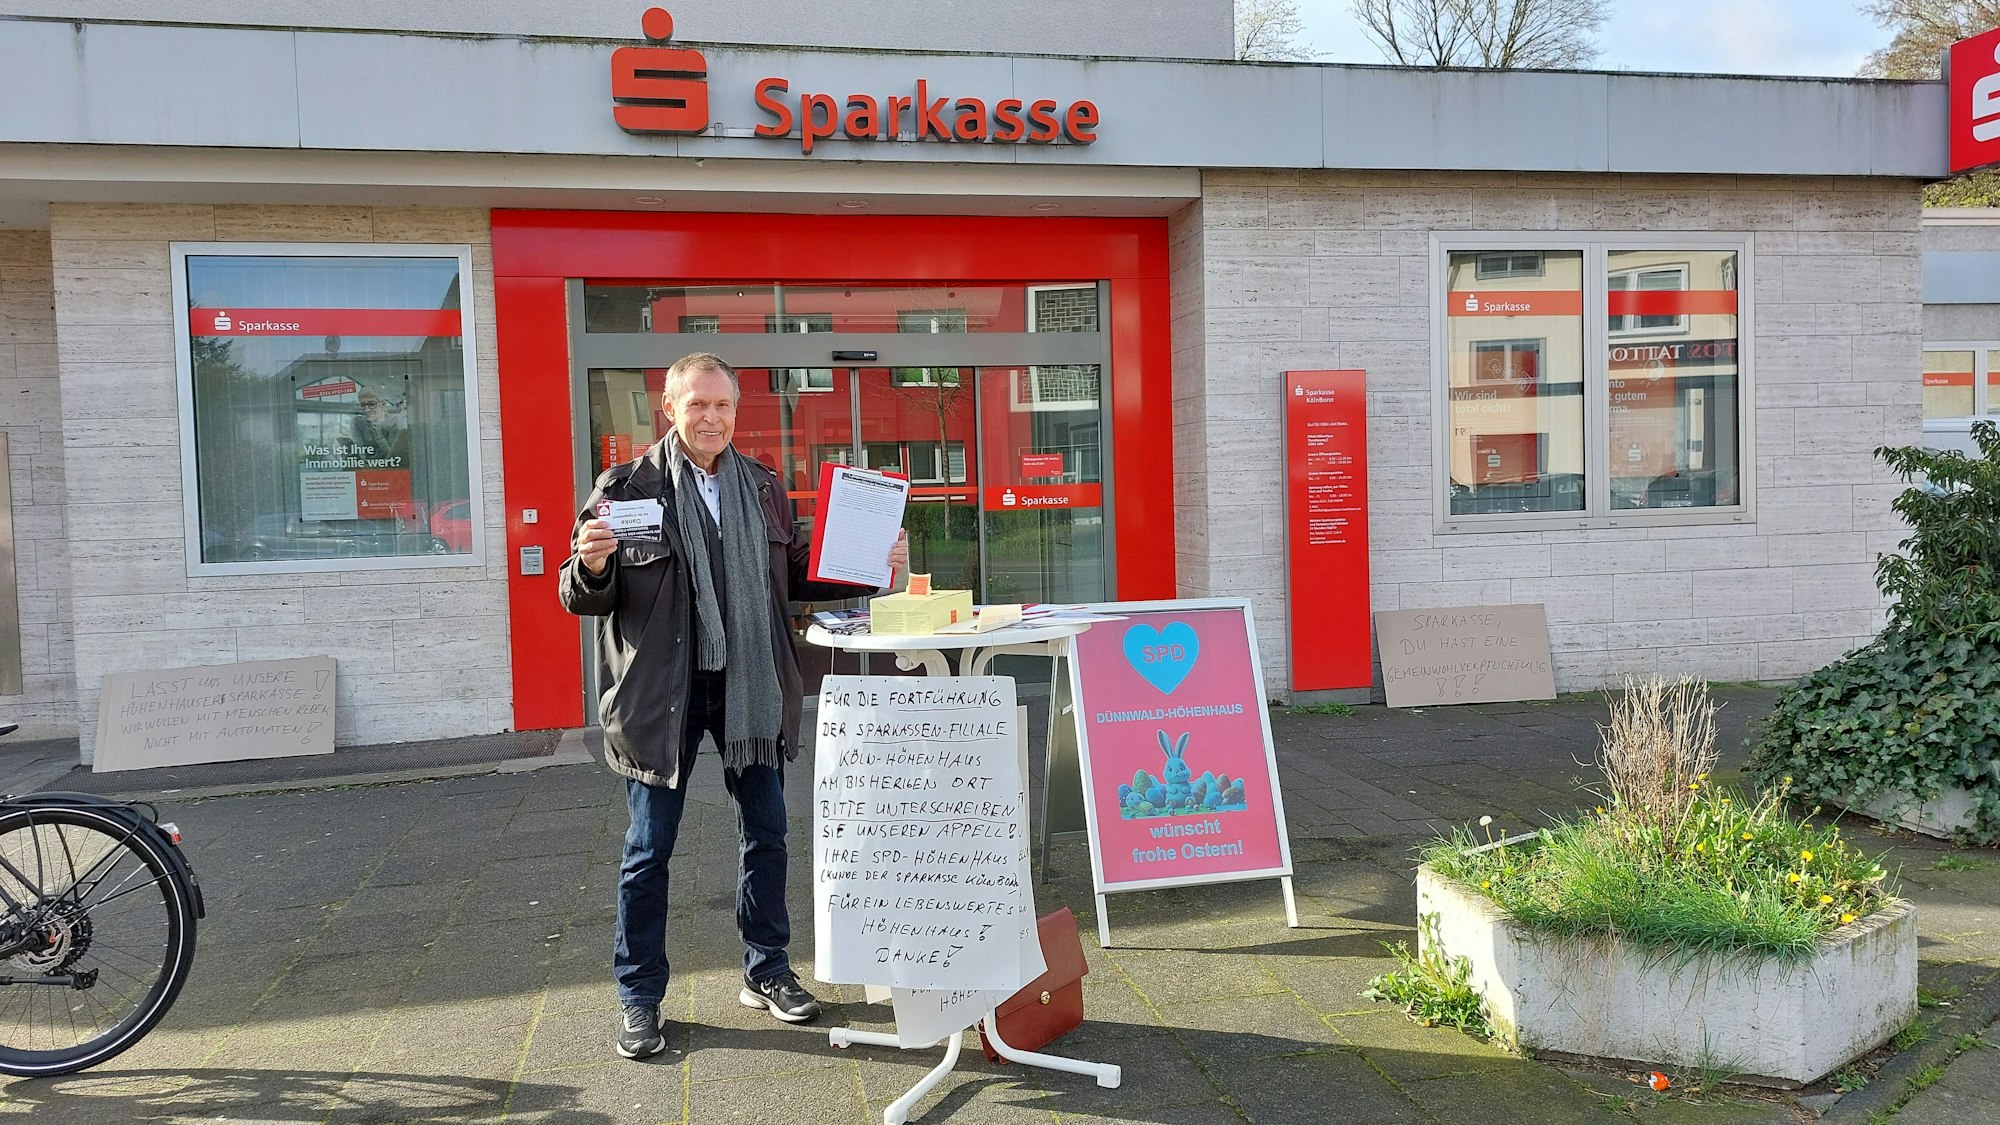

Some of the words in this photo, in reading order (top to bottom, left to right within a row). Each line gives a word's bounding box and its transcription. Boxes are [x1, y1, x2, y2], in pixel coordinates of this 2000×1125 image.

[754, 77, 1099, 155] Sparkasse
[1484, 301, 1531, 314] Sparkasse
[238, 320, 300, 333] Sparkasse
[1454, 390, 1473, 400] Wir
[1475, 390, 1497, 400] sind
[1615, 392, 1647, 404] gutem
[1455, 404, 1479, 414] total
[304, 445, 330, 456] Was
[332, 444, 348, 455] ist
[350, 444, 375, 455] Ihre
[305, 457, 365, 468] Immobilie
[367, 456, 402, 468] wert?
[1021, 496, 1068, 507] Sparkasse
[1142, 644, 1186, 663] SPD
[1400, 638, 1426, 655] DU
[1440, 636, 1476, 649] HAST
[1484, 636, 1519, 648] EINE
[131, 678, 194, 699] LASST
[199, 677, 220, 688] UNS
[232, 670, 296, 684] UNSERE
[230, 688, 307, 702] SPARKASSE
[824, 685, 850, 708] FÜR
[858, 692, 880, 706] DIE
[890, 689, 1002, 707] FORTFÜHRUNG
[121, 722, 150, 735] WIR
[196, 711, 218, 724] MIT
[226, 706, 292, 720] MENSCHEN
[1096, 704, 1244, 724] DÜNNWALD-HÖHENHAUS
[144, 736, 177, 750] NICHT
[189, 730, 210, 742] MIT
[216, 724, 302, 739] AUTOMATEN
[822, 722, 846, 738] DER
[856, 721, 1008, 738] SPARKASSEN-FILIALE
[818, 778, 838, 791] AM
[846, 775, 936, 790] BISHERIGEN
[952, 776, 994, 790] ORT
[820, 800, 866, 818] BITTE
[876, 800, 1015, 817] UNTERSCHREIBEN
[822, 824, 846, 838] SIE
[856, 824, 930, 838] UNSEREN
[1149, 819, 1222, 839] wünscht
[824, 848, 859, 864] IHRE
[1132, 845, 1176, 863] frohe
[1182, 840, 1244, 860] Ostern!
[865, 870, 888, 881] DER
[896, 872, 958, 884] SPARKASSE
[828, 893, 858, 912] FÜR
[864, 896, 890, 910] EIN
[896, 897, 1013, 916] LEBENSWERTES
[862, 916, 970, 938] HÖHENHAUS
